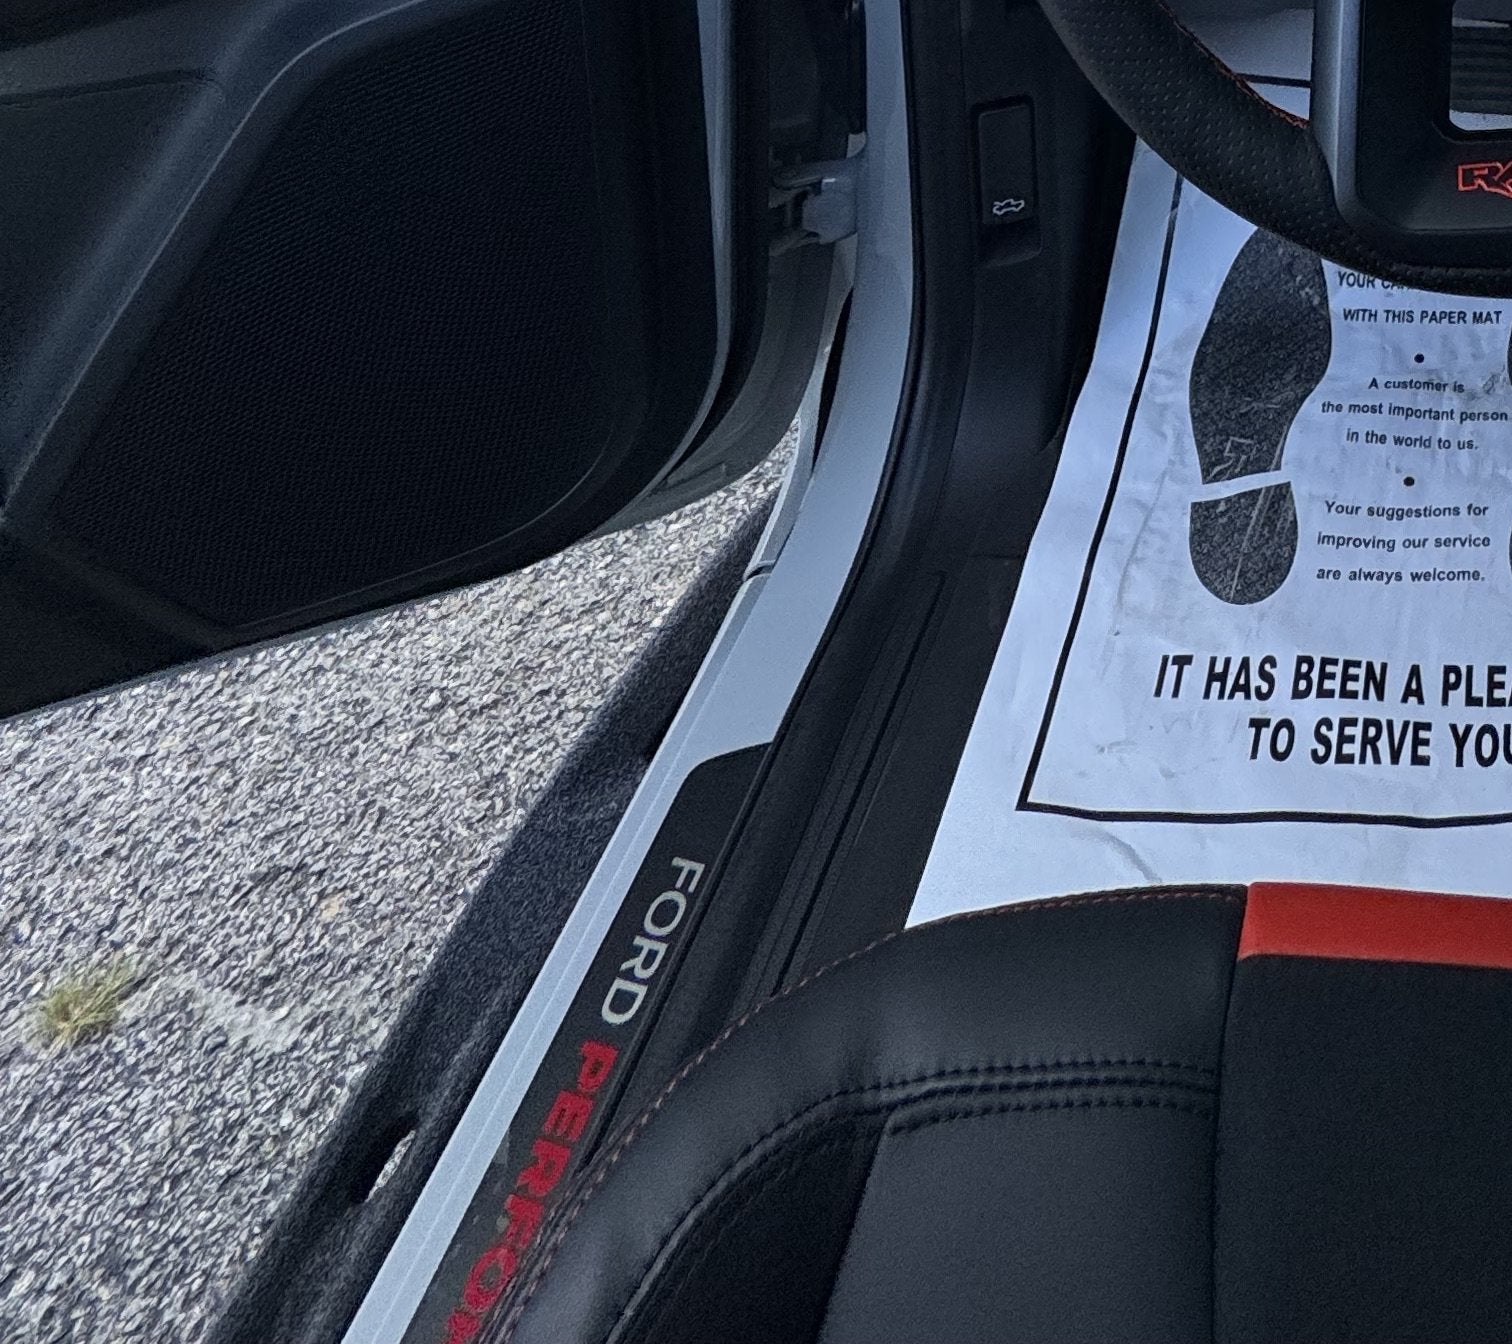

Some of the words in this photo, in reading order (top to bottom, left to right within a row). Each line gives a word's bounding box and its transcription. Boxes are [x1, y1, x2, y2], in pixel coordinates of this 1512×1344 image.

[1338, 271, 1376, 289] YOUR
[1343, 308, 1378, 323] WITH
[1384, 309, 1414, 324] THIS
[1419, 309, 1467, 325] PAPER
[1472, 310, 1501, 325] MAT
[1369, 377, 1379, 390] A
[1384, 377, 1448, 392] customer
[1453, 382, 1465, 394] is
[1321, 401, 1343, 414] the
[1348, 403, 1383, 415] most
[1388, 405, 1455, 423] important
[1460, 409, 1509, 424] person
[1346, 428, 1359, 443] in
[1365, 430, 1387, 445] the
[1393, 433, 1433, 449] world
[1437, 437, 1452, 450] to
[1456, 439, 1478, 451] us.
[1325, 501, 1360, 515] Your
[1367, 506, 1461, 521] suggestions
[1466, 503, 1488, 517] for
[1317, 534, 1396, 550] improving
[1402, 538, 1428, 549] our
[1434, 536, 1491, 548] service
[1316, 568, 1341, 580] are
[1348, 570, 1403, 583] always
[1410, 570, 1484, 582] welcome.
[1154, 654, 1193, 700] IT
[1204, 654, 1276, 702] HAS
[1292, 655, 1387, 701] BEEN
[1401, 663, 1424, 705] A
[1250, 717, 1295, 762] TO
[1312, 716, 1431, 767] SERVE
[600, 855, 707, 1028] FORD
